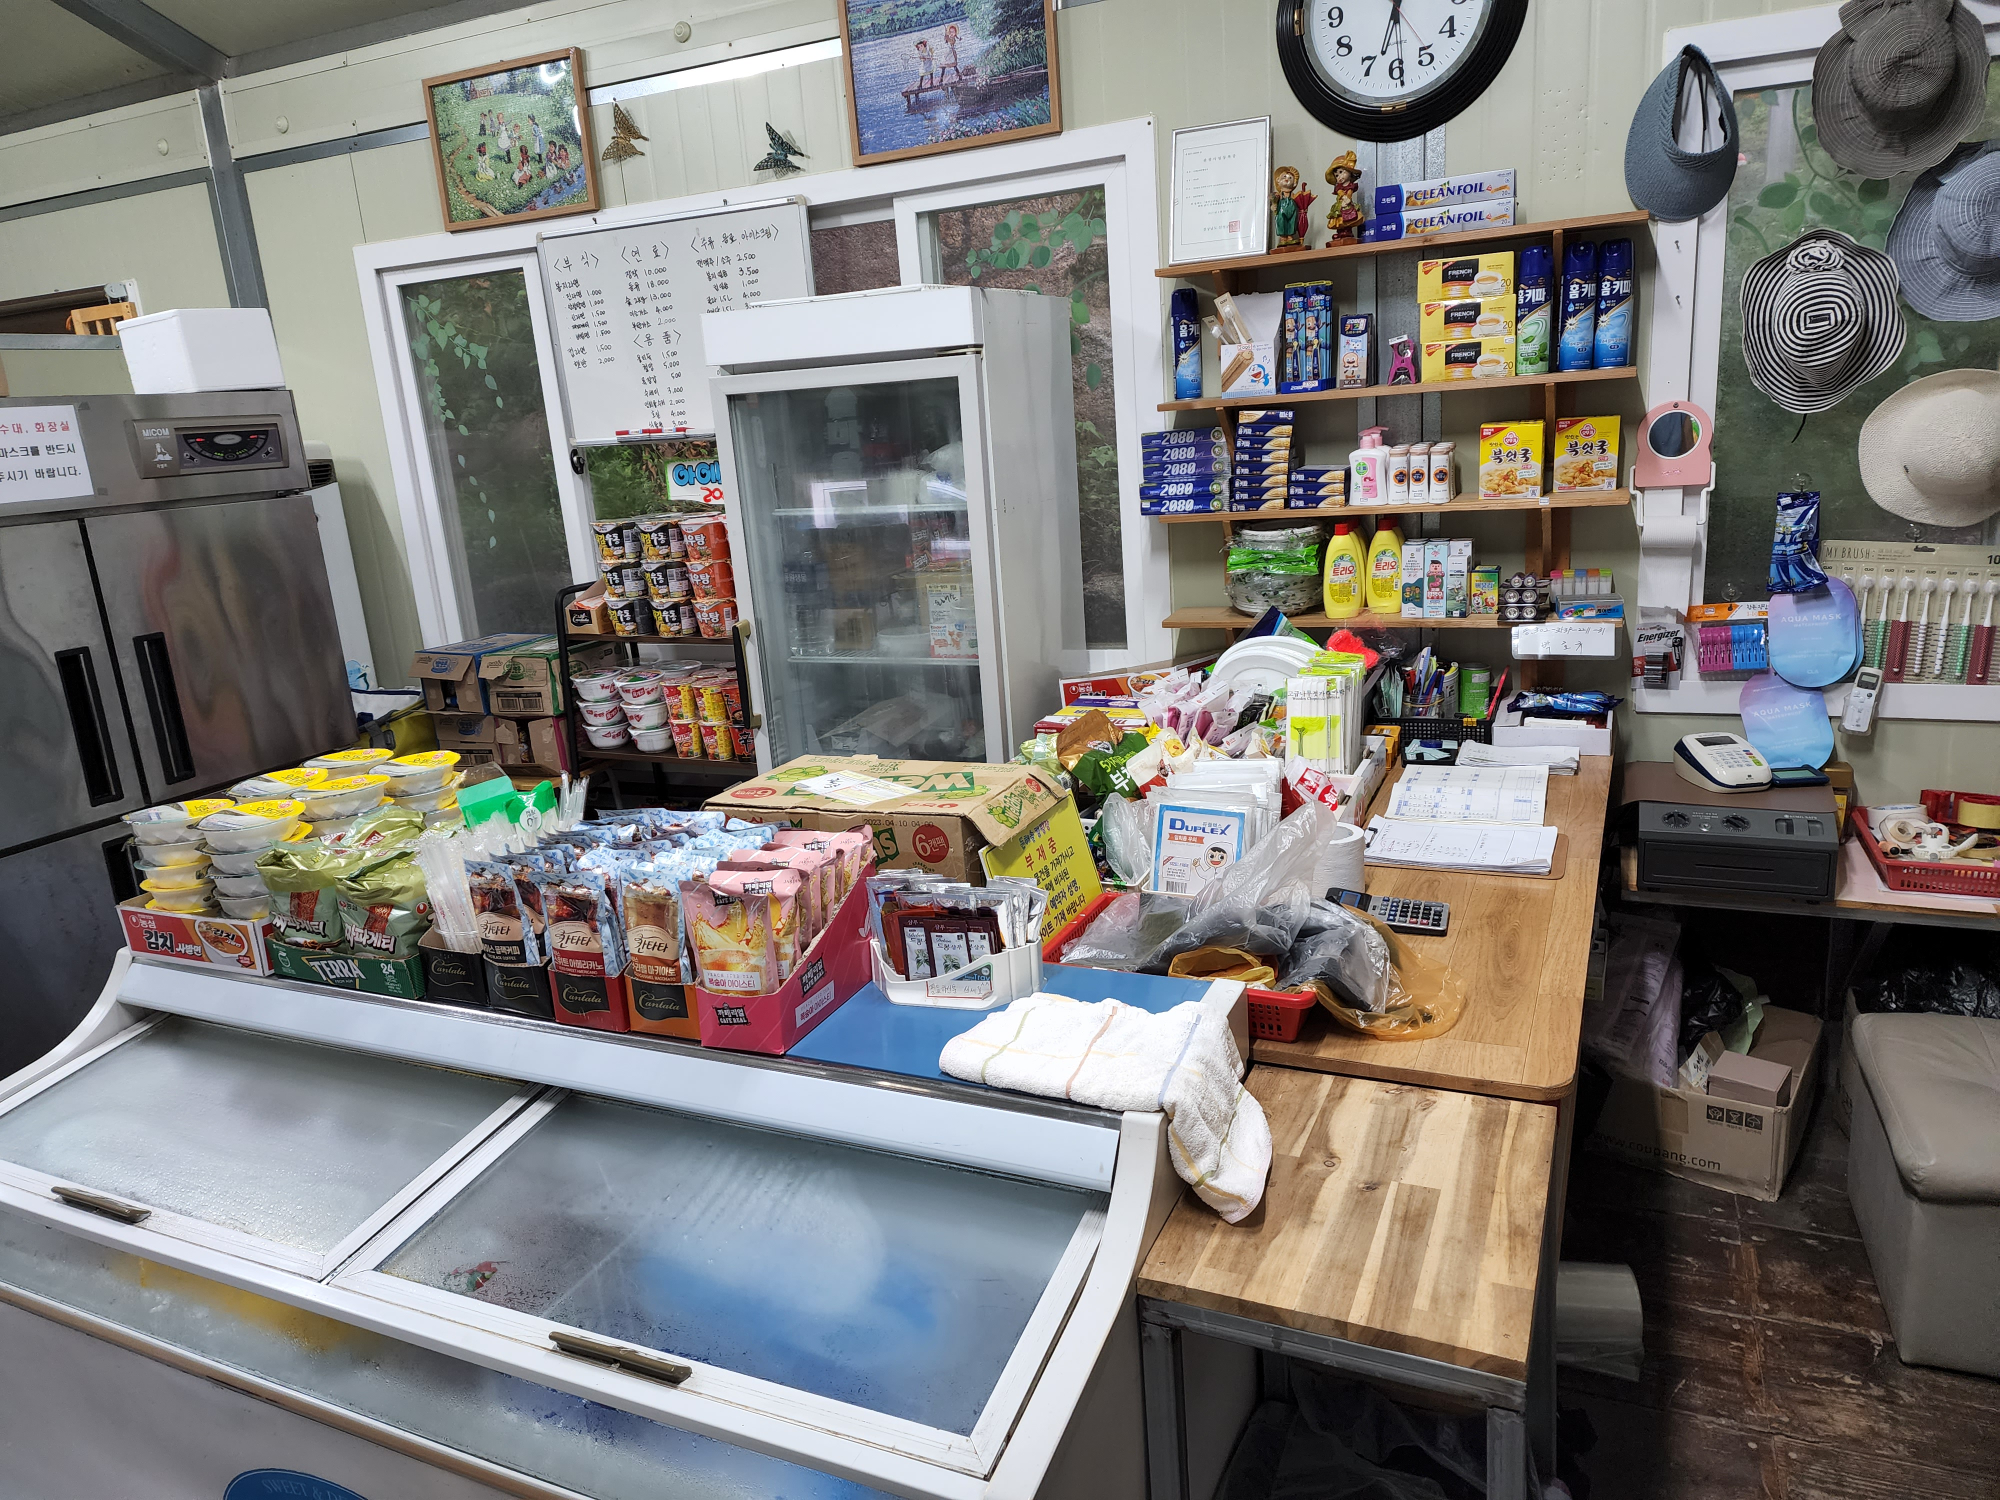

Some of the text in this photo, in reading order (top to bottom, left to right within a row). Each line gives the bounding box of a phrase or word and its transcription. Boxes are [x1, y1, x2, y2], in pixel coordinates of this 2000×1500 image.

[1327, 6, 1344, 28] 9
[1438, 14, 1457, 39] 4
[1336, 35, 1353, 57] 8
[1417, 43, 1435, 67] 5
[1361, 55, 1378, 77] 7
[1388, 58, 1405, 81] 6
[1500, 278, 1511, 288] 20
[1502, 320, 1514, 330] 20
[1502, 361, 1514, 370] 20
[34, 420, 70, 433] 화장실
[141, 427, 170, 437] MICOM
[1162, 430, 1195, 445] 2080
[45, 443, 76, 456] 반드시
[1162, 446, 1196, 461] 2080
[1489, 447, 1532, 464] 북엇국
[1565, 440, 1610, 456] 북엇국
[34, 466, 82, 479] 바랍니다.
[1163, 462, 1196, 476] 2080
[1160, 482, 1193, 496] 2080
[1161, 499, 1194, 512] 2080
[1825, 547, 1838, 559] MY
[1332, 565, 1355, 577] 트리오
[1374, 560, 1398, 572] 트리오
[1781, 613, 1842, 623] AQUA MASK
[1637, 629, 1681, 643] Energizer
[1754, 701, 1813, 718] AQUA MASK
[738, 731, 752, 753] 辛
[1050, 846, 1075, 871] 가져가시고
[1054, 870, 1071, 887] 비치된
[1066, 893, 1088, 916] 바랍니다
[143, 929, 203, 957] 김치 사발면
[309, 959, 367, 981] TERRA
[380, 962, 395, 975] 24
[570, 957, 604, 970] 아메리카노
[708, 978, 727, 988] 복숭아
[562, 984, 602, 1003] Cantata
[638, 990, 680, 1010] Cantata
[261, 1478, 307, 1497] SWEET
